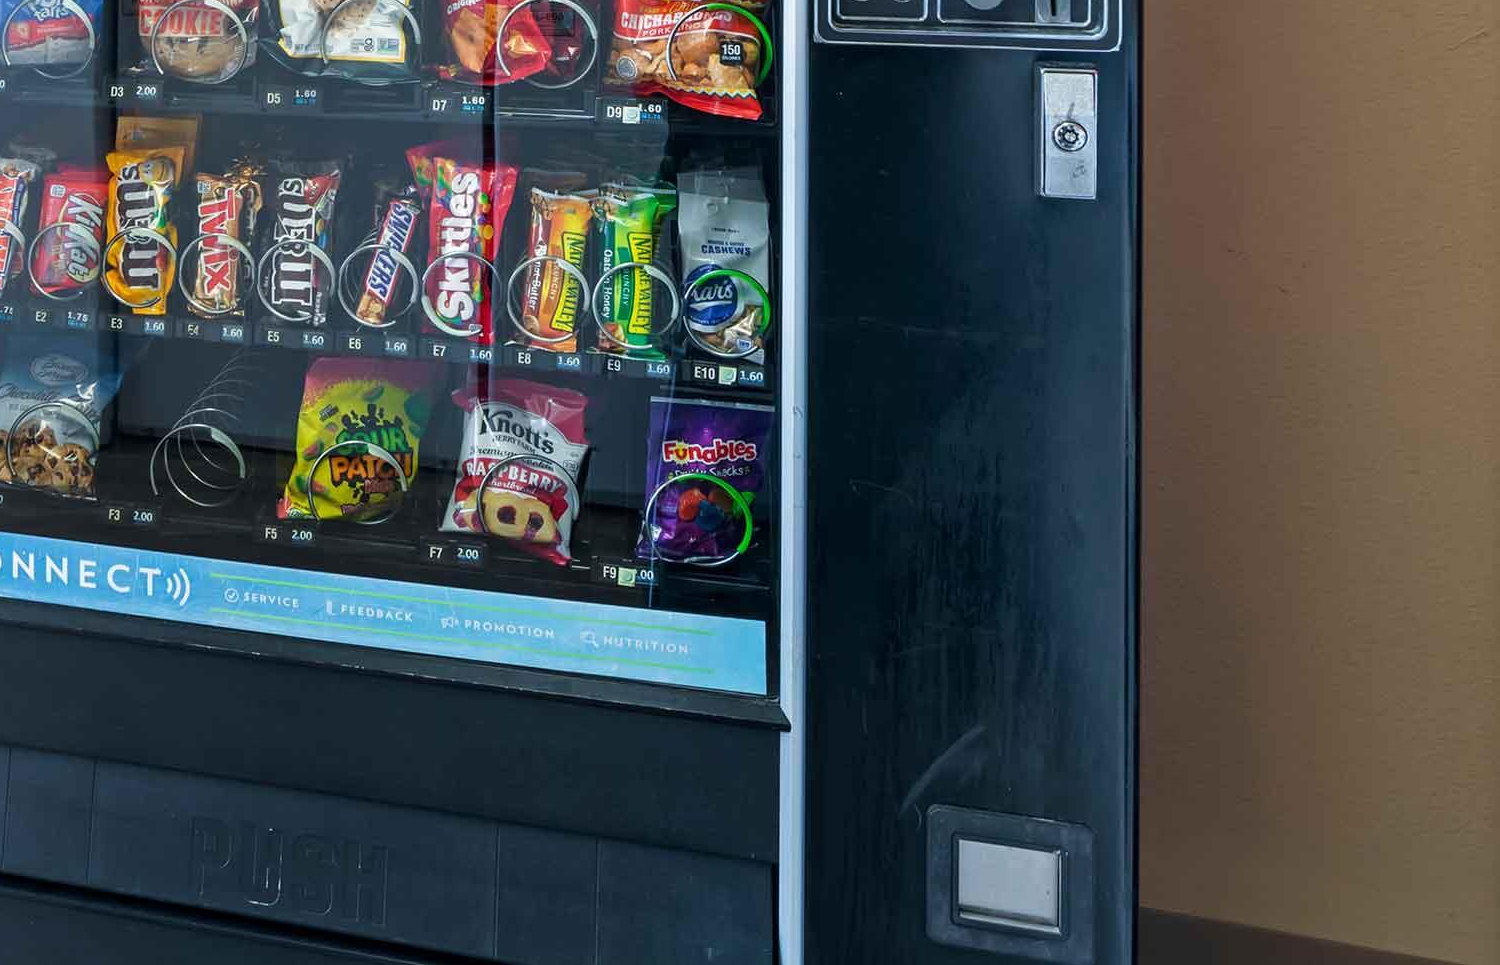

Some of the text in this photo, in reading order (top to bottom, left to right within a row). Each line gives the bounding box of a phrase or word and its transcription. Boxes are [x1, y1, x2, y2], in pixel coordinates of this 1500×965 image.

[433, 96, 485, 111] D7 1.60
[436, 172, 480, 321] Skittles
[701, 244, 751, 257] CASHEWS
[433, 345, 492, 360] E7 1.60
[694, 367, 763, 382] E10 1.60
[478, 407, 556, 454] Knott's
[663, 439, 756, 465] Funables
[265, 527, 312, 541] F5 2.00
[243, 591, 300, 609] SERVICE
[341, 603, 413, 623] FEEDBACK
[464, 618, 555, 639] PROMOTION
[603, 635, 690, 655] NUTRITION
[194, 814, 389, 930] PUSH
